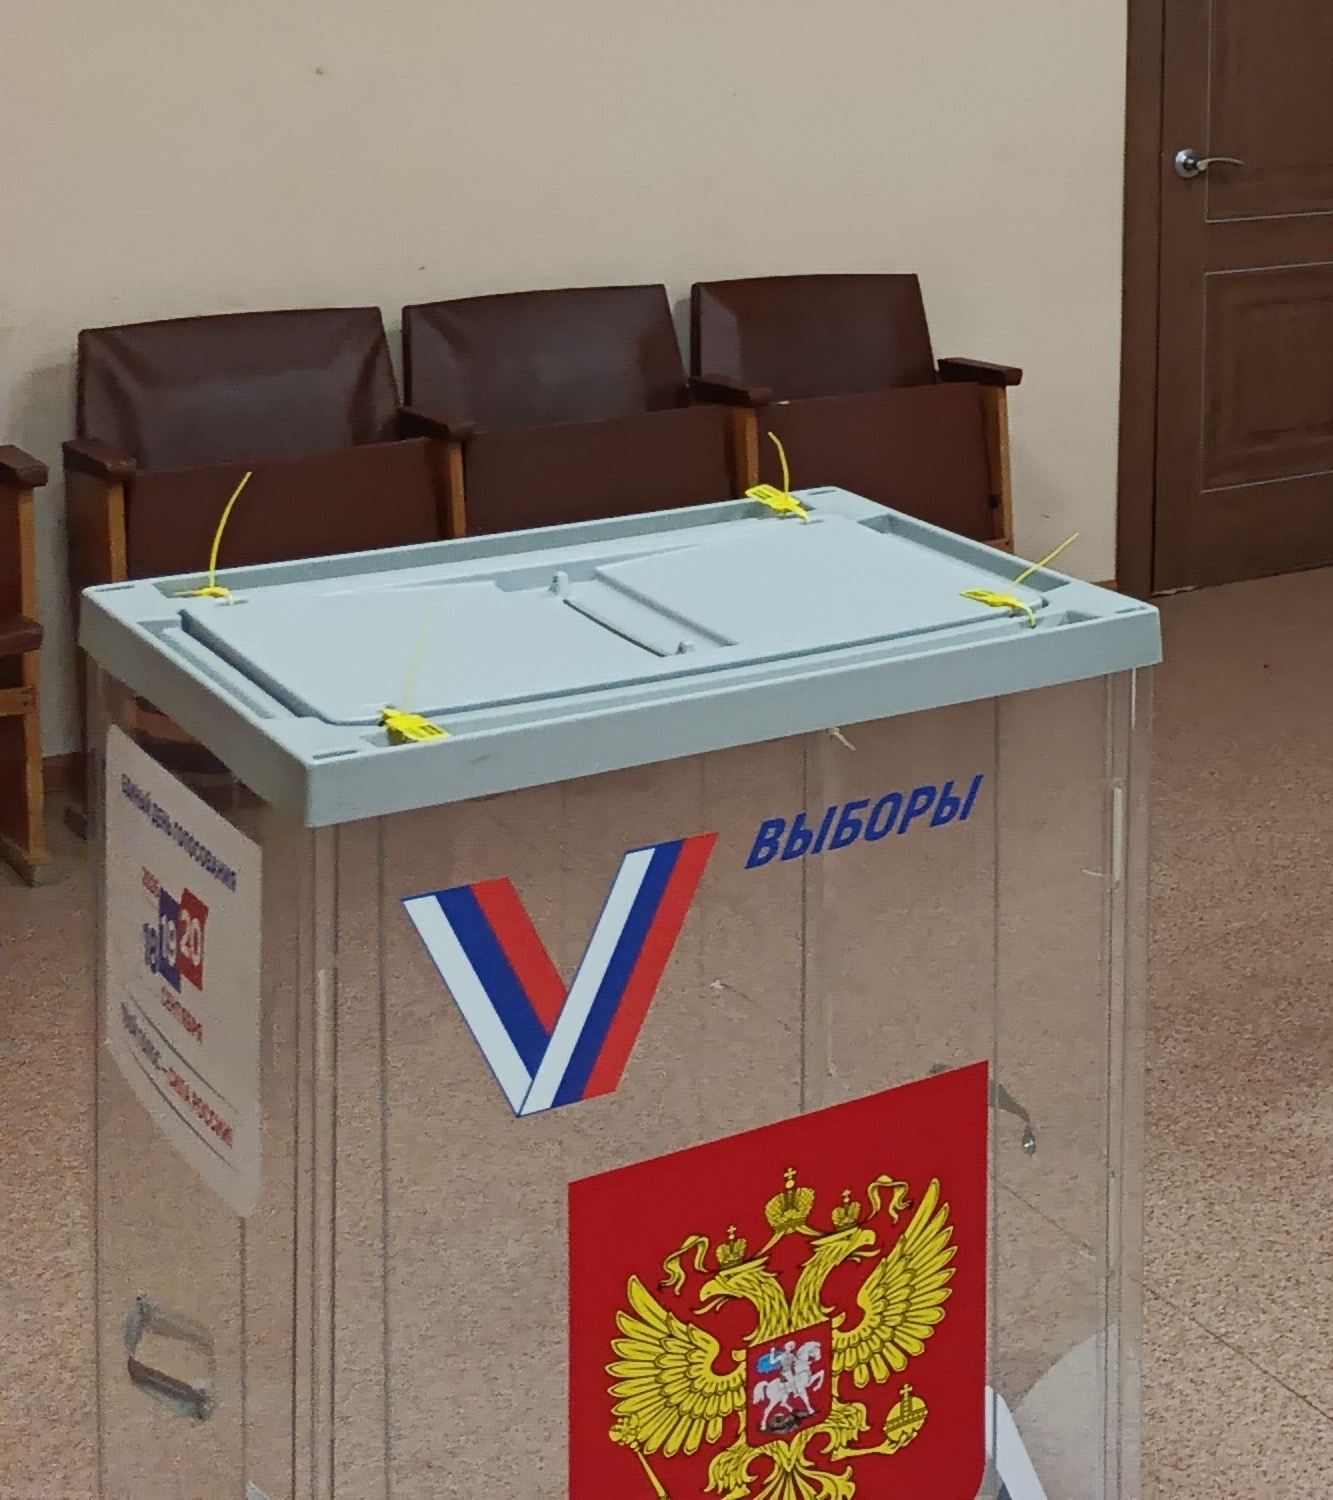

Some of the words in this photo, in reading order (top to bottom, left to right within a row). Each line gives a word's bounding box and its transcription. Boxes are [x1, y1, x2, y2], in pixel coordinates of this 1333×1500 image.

[744, 774, 984, 869] ВЫБОРЫ
[159, 913, 177, 967] 19
[180, 908, 201, 967] 20
